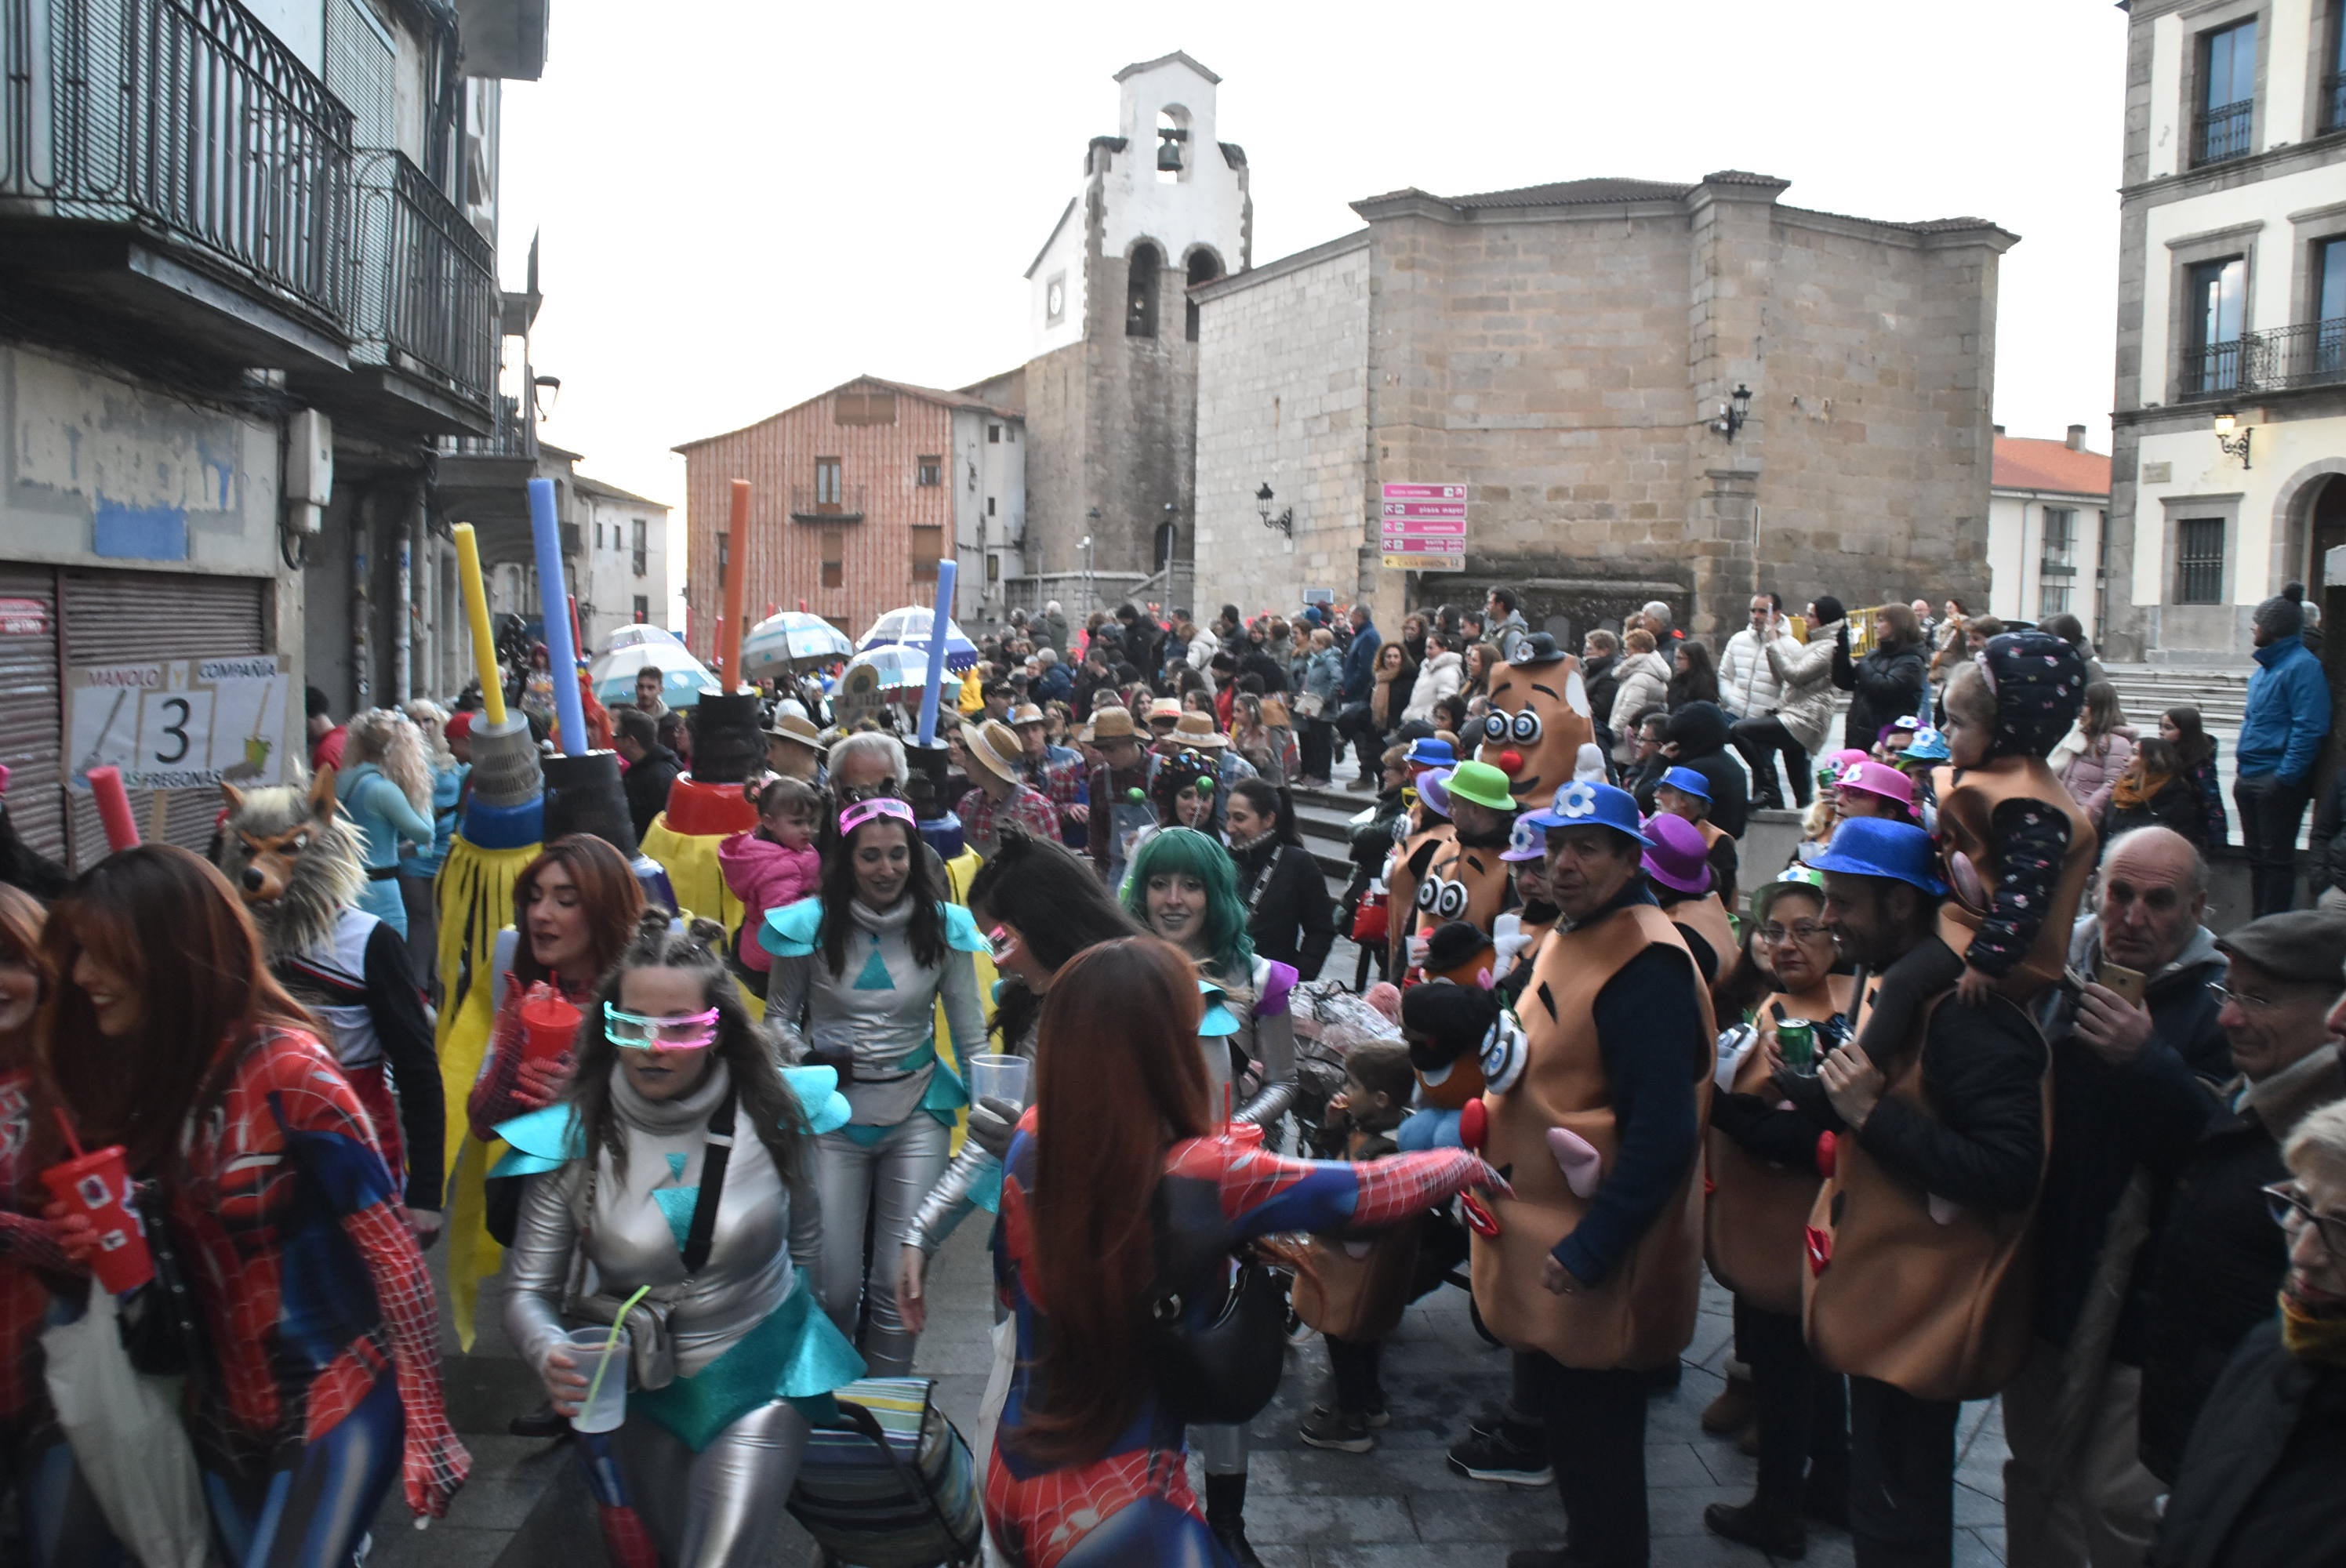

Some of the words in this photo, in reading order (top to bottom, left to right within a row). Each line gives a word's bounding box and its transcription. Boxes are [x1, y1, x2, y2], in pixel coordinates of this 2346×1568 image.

[89, 669, 158, 687] MANOLO
[174, 670, 183, 684] Y
[155, 697, 191, 764] 3
[143, 770, 223, 788] FREGONAS
